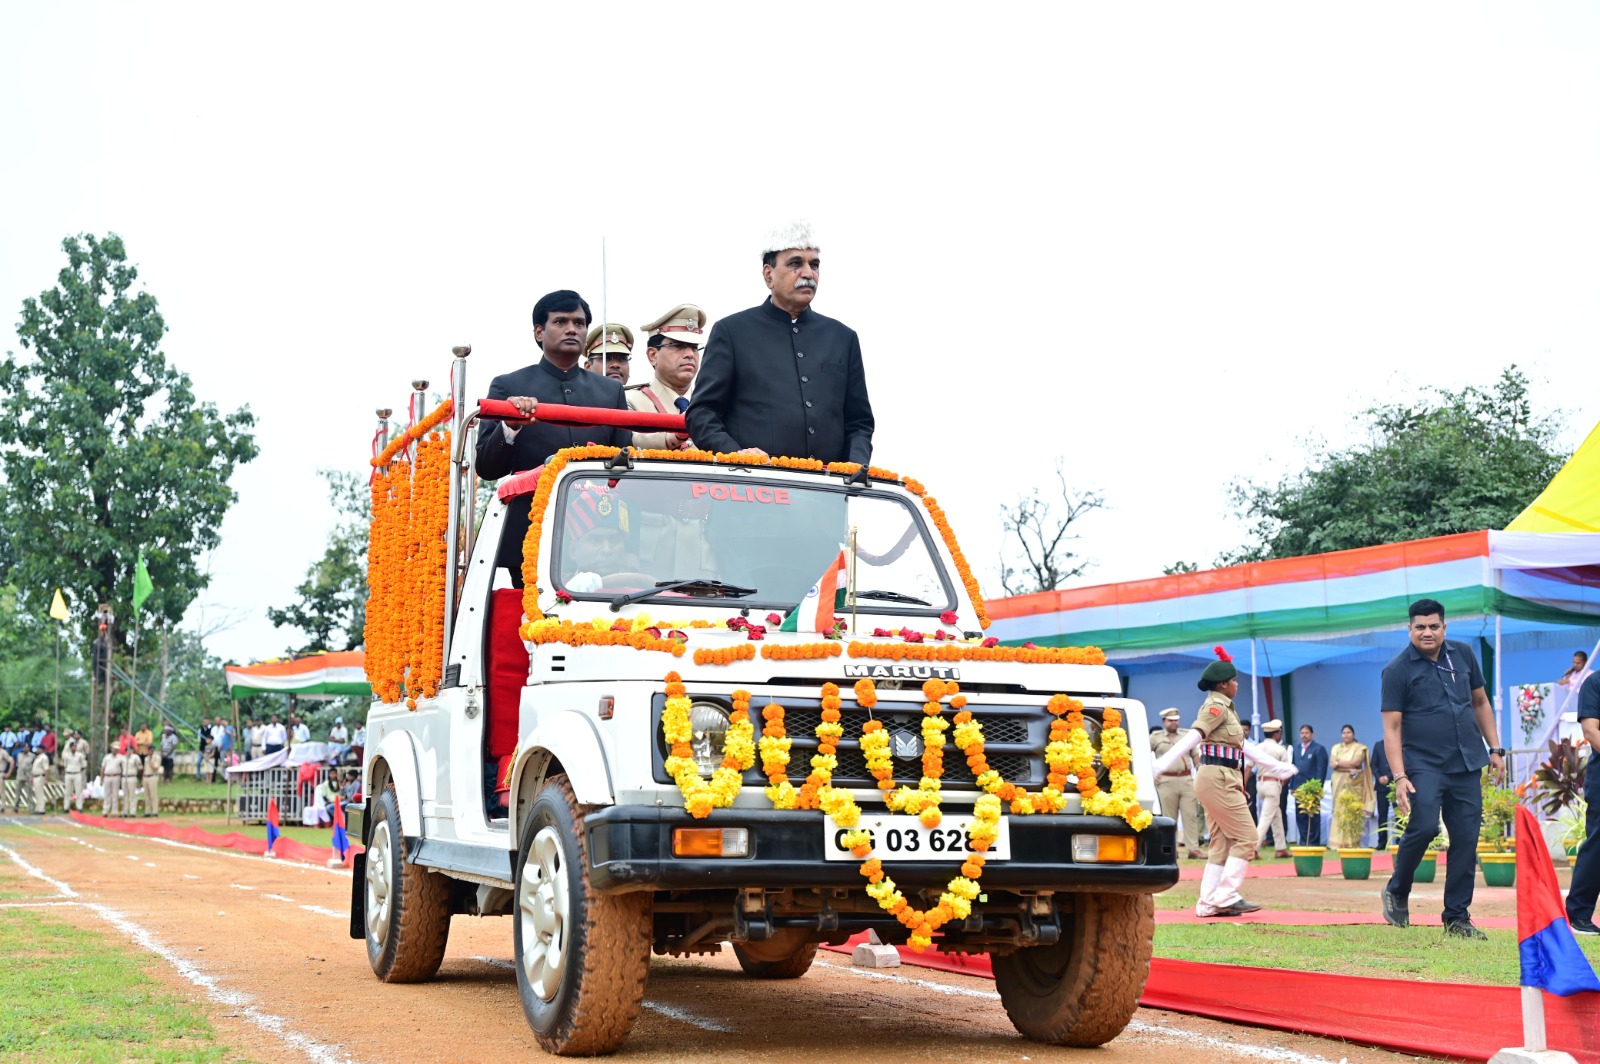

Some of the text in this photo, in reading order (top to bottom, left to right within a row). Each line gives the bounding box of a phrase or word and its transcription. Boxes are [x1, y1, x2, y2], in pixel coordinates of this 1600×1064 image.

[691, 482, 792, 505] POLICE
[844, 665, 960, 680] MARUTI
[886, 829, 920, 852] 03
[929, 829, 997, 852] 628
